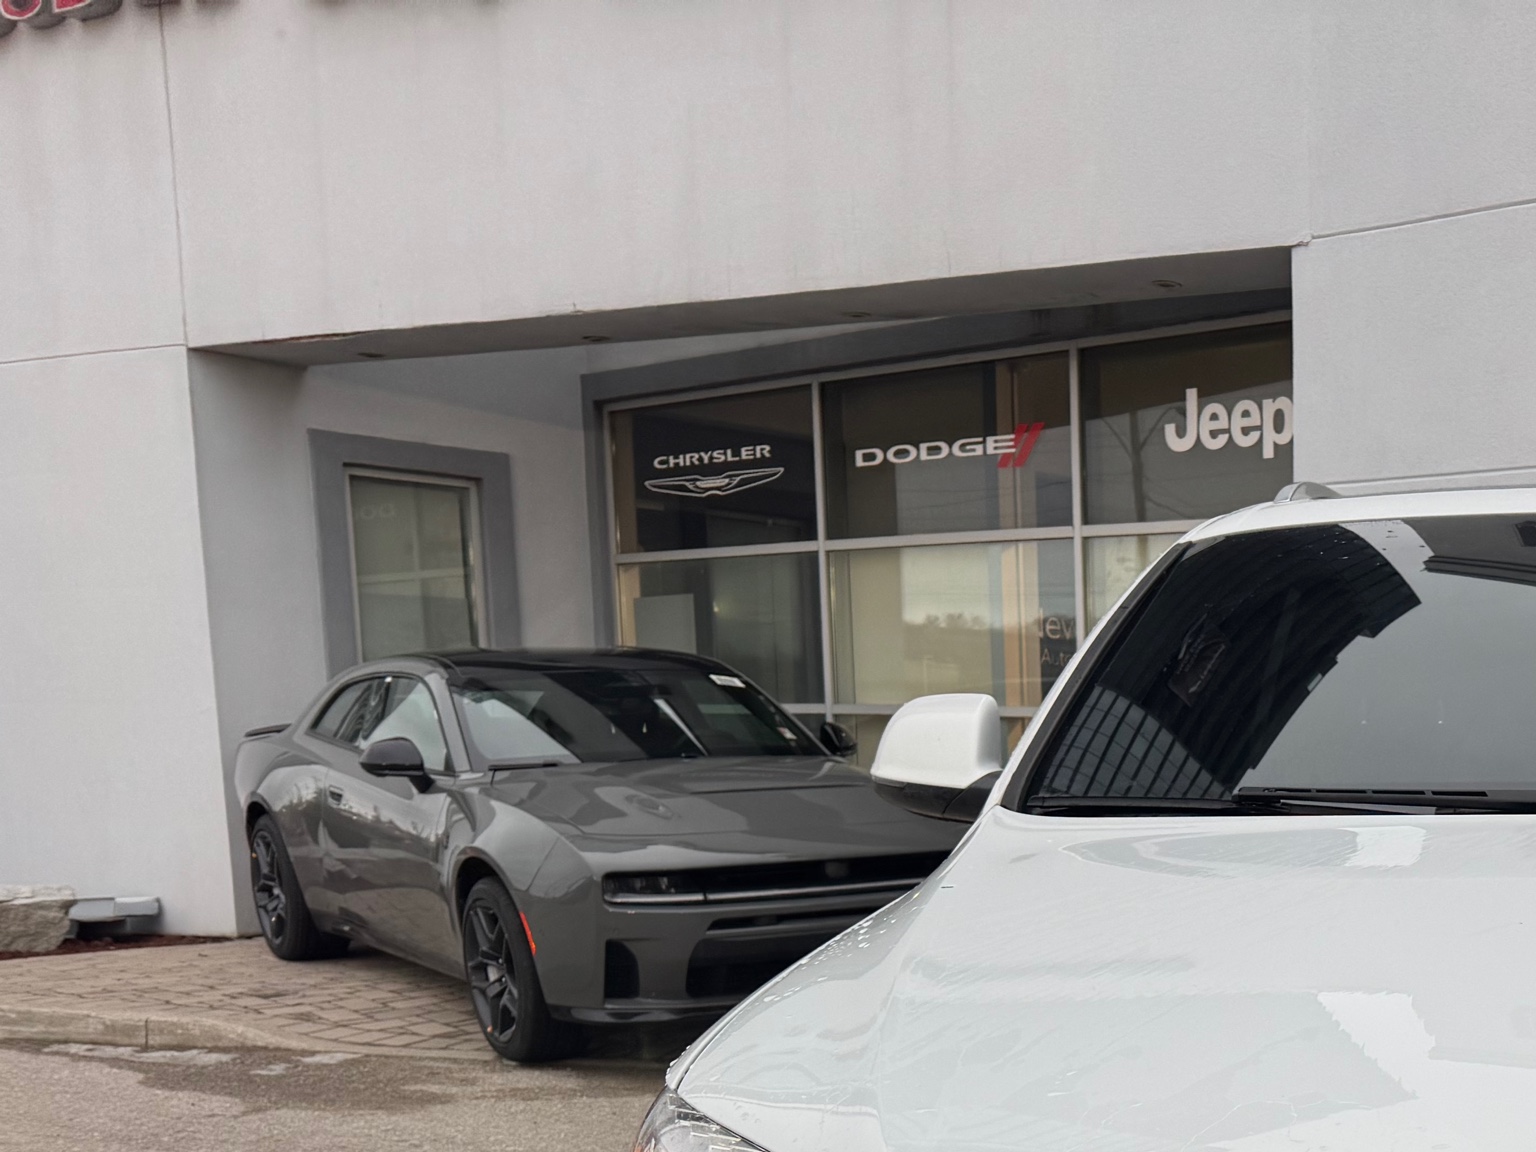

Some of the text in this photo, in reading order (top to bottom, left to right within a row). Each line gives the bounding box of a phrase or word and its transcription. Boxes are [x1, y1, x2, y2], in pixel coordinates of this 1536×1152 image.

[1164, 387, 1293, 459] Jeep
[652, 444, 772, 469] CHRYSLER
[854, 433, 1016, 467] DODGE
